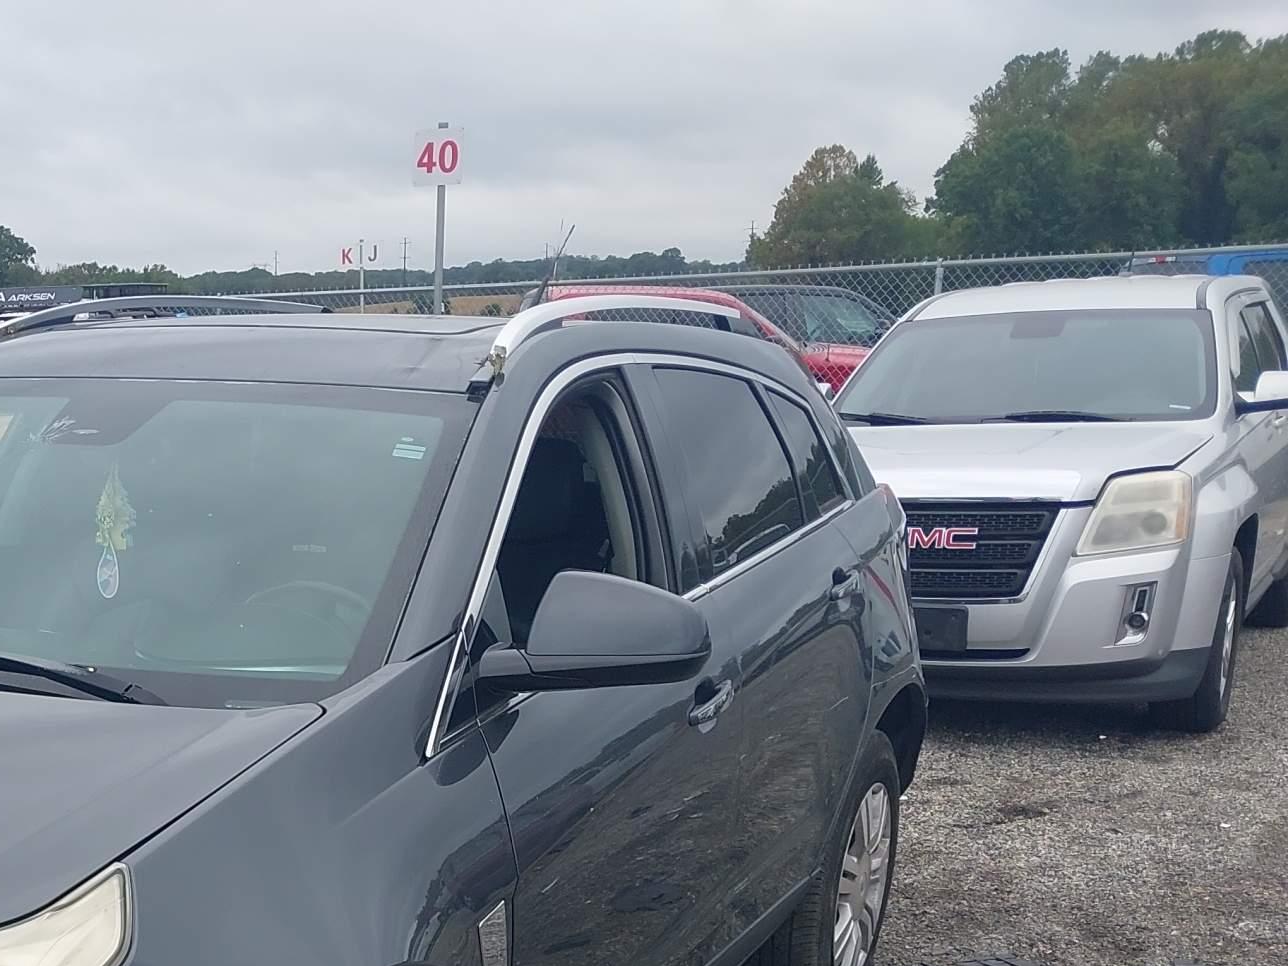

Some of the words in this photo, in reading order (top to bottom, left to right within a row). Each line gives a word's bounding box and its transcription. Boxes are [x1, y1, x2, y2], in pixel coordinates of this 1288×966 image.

[417, 140, 458, 173] 40
[342, 247, 353, 265] K
[367, 244, 377, 262] J
[7, 292, 56, 302] ARKSEN
[907, 527, 979, 549] MC
